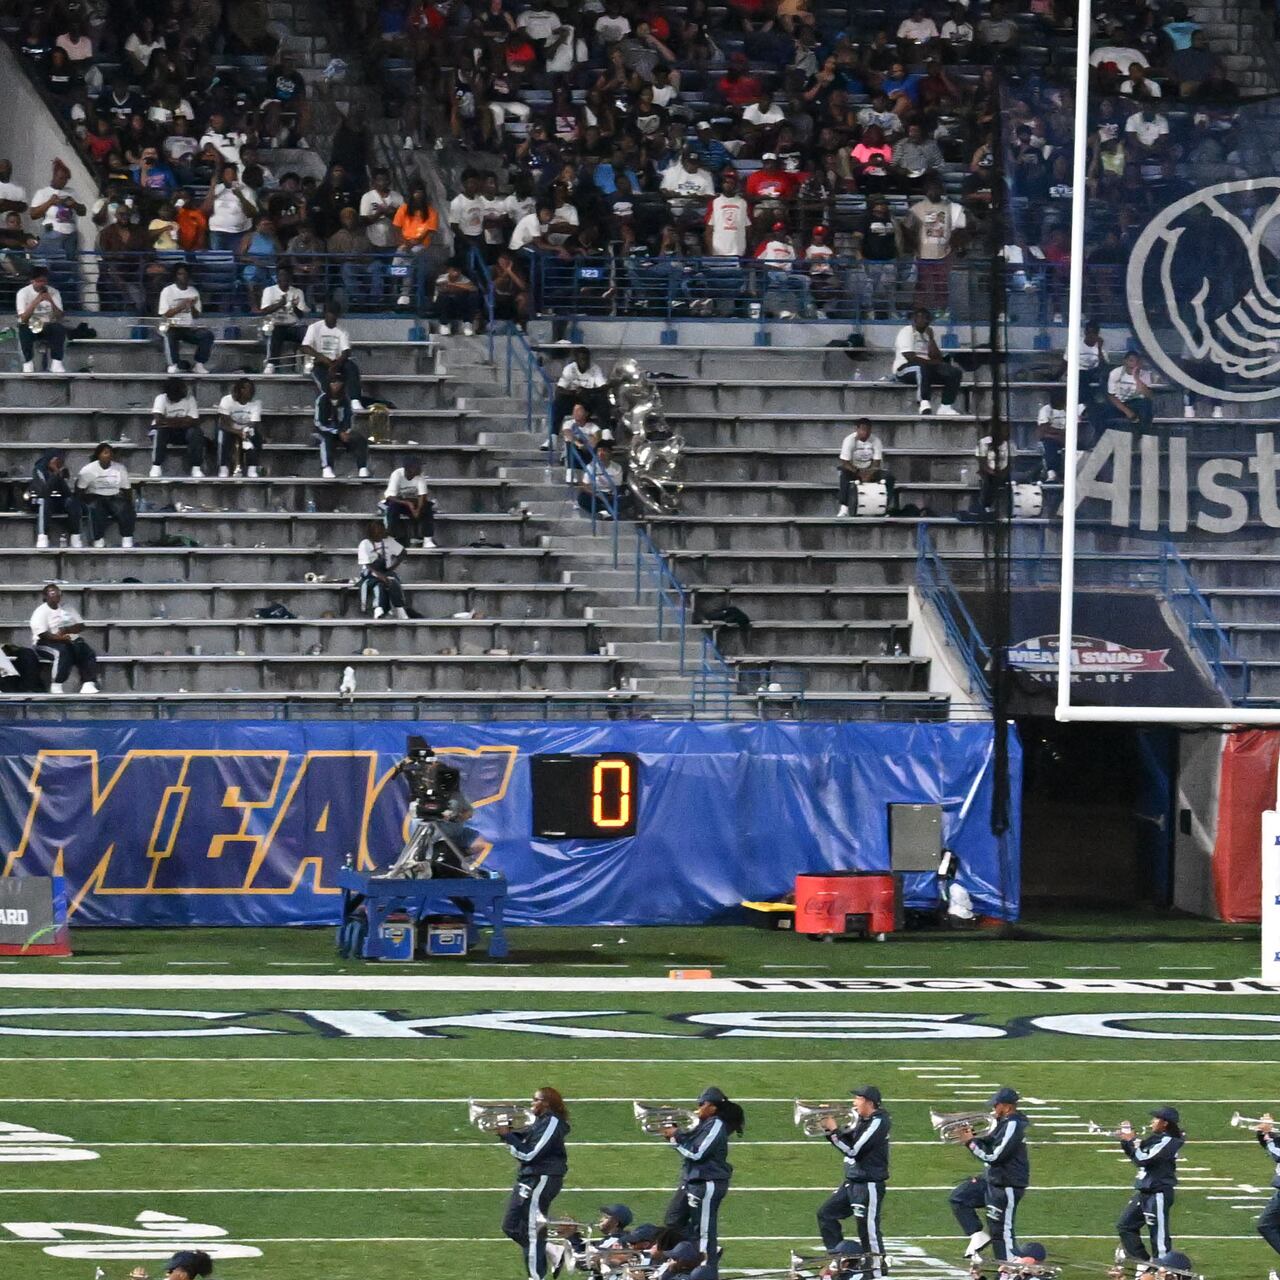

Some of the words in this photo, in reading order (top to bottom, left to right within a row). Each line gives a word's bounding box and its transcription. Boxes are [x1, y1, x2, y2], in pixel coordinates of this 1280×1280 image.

[581, 269, 599, 278] 123
[1082, 651, 1145, 664] SWAC
[1029, 673, 1134, 684] KIK-OFF
[592, 759, 631, 827] 0
